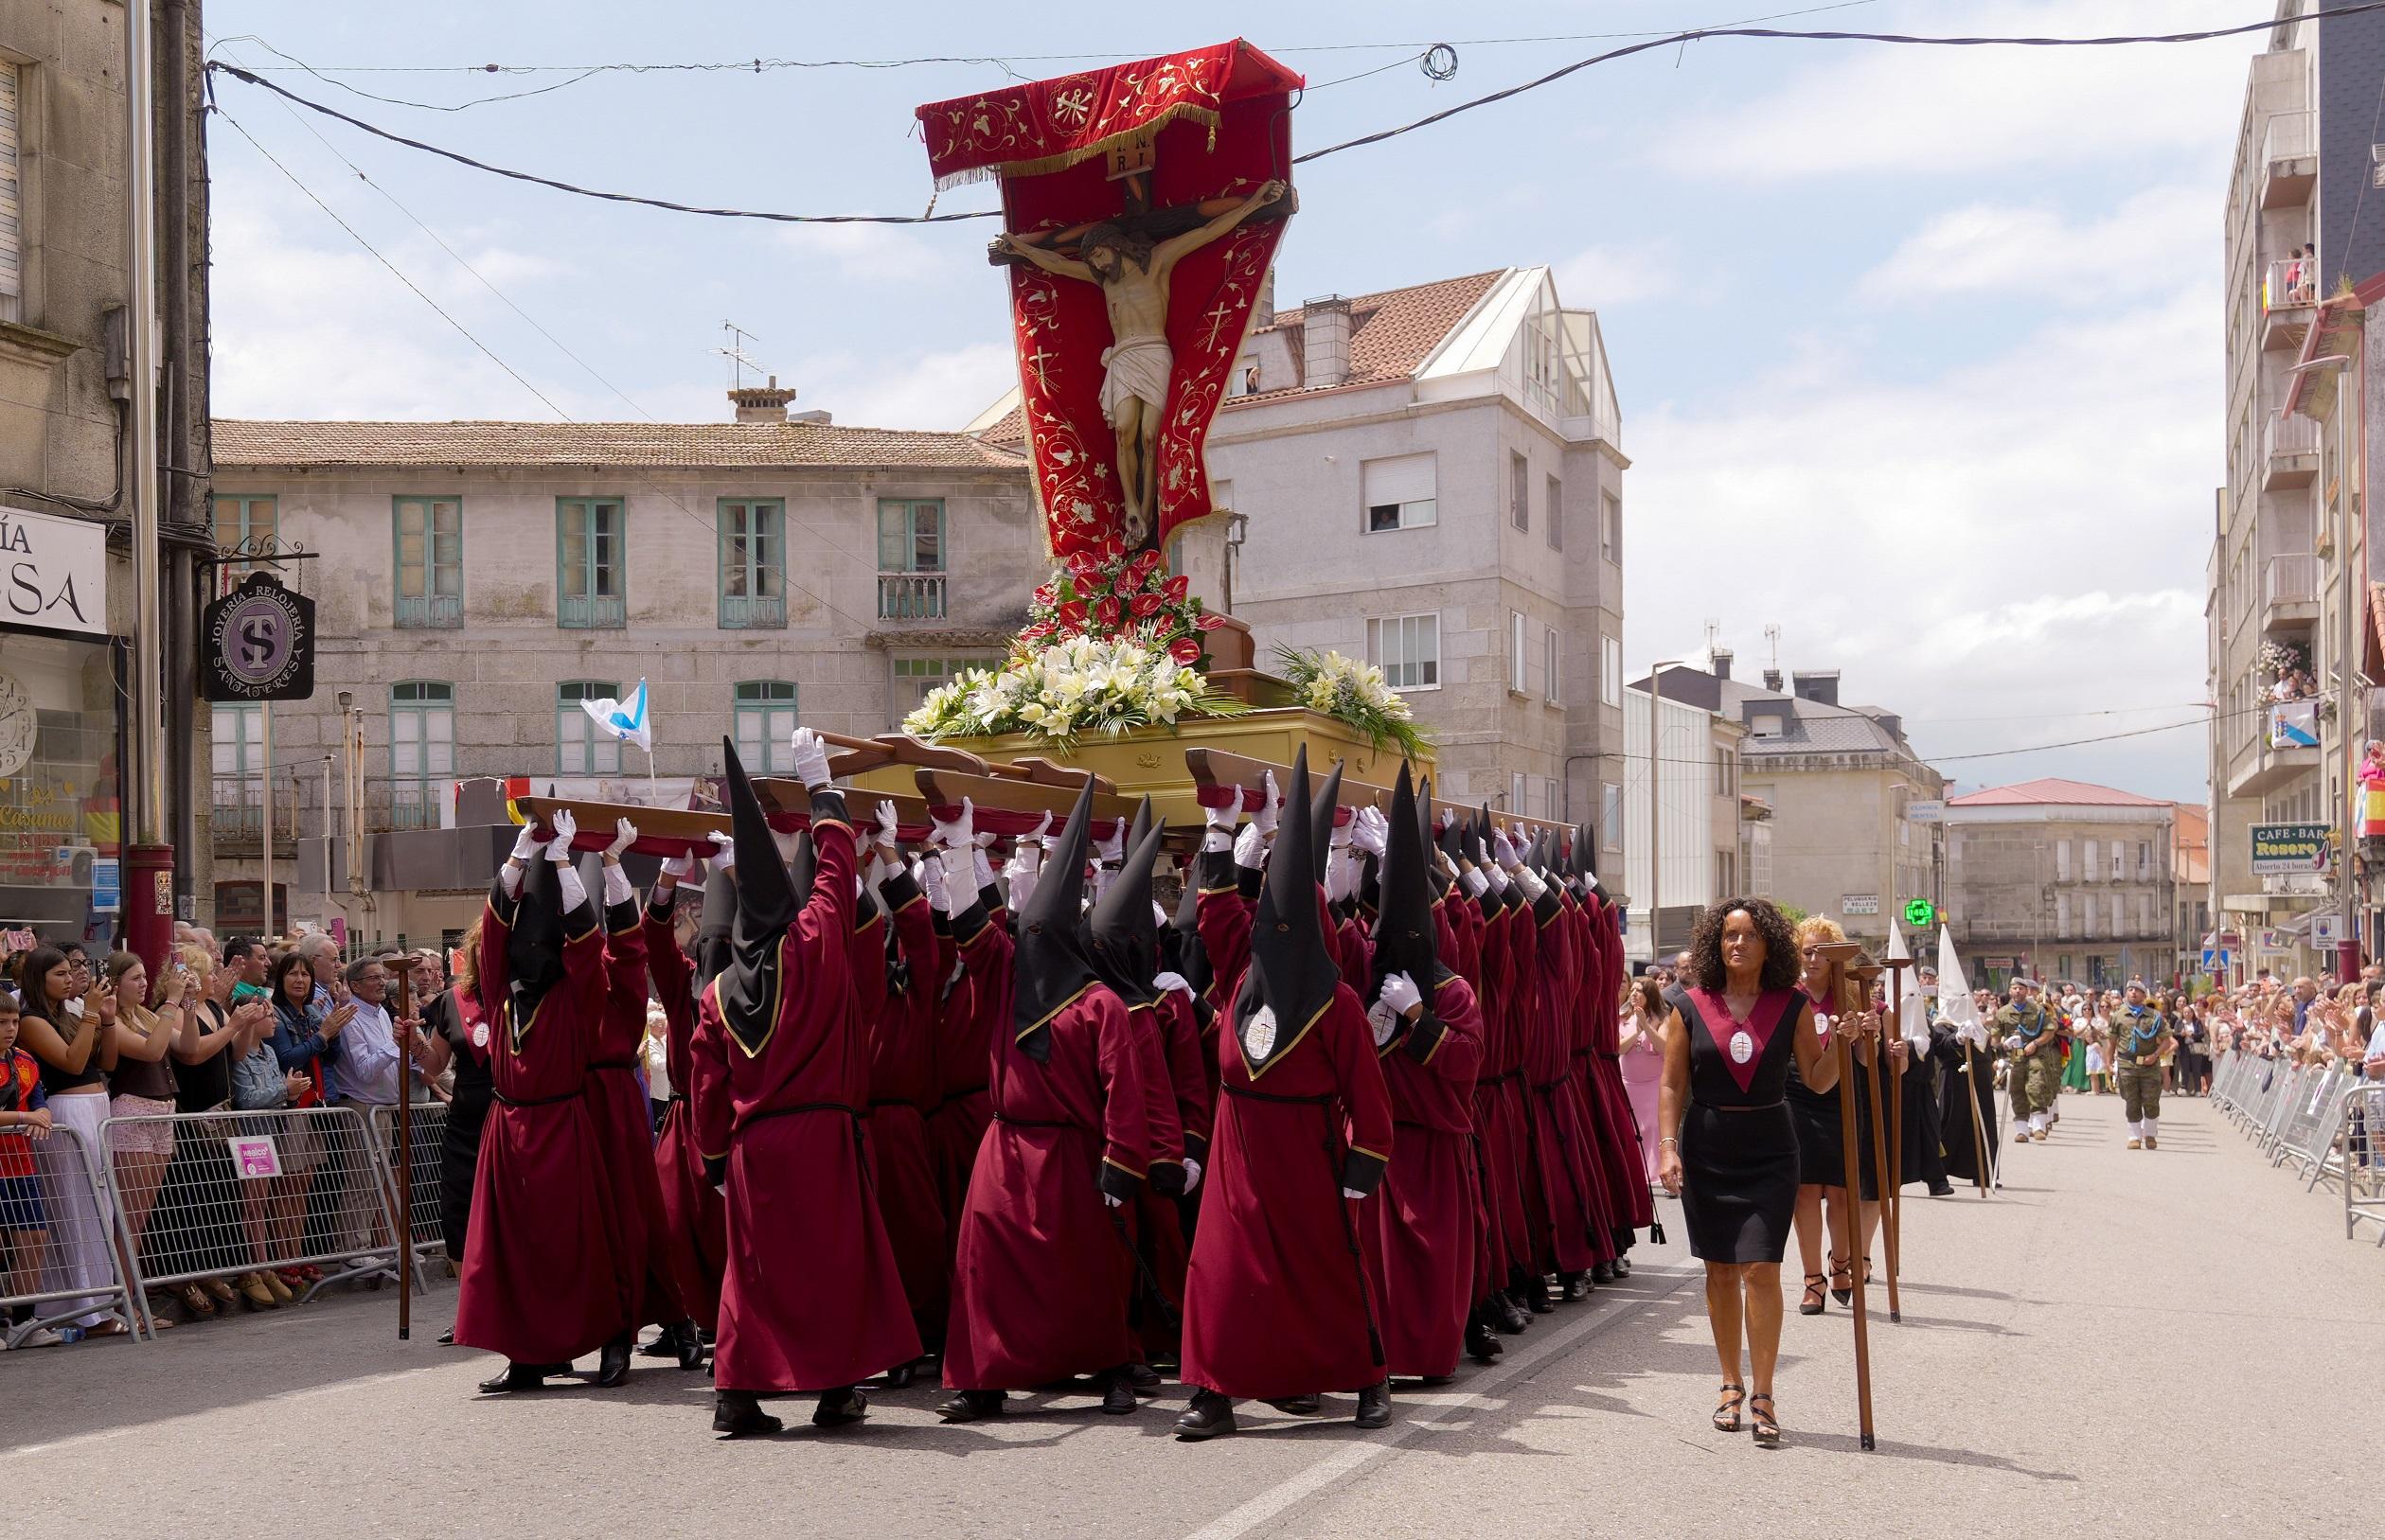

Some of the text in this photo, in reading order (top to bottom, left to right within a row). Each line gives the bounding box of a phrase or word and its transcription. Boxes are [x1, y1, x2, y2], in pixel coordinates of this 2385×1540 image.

[0, 514, 32, 554] ÍA
[0, 562, 88, 624] SA
[212, 592, 246, 646] JOYERÍA
[256, 586, 305, 641] RELOJERÍA
[2257, 828, 2289, 841] CAFE
[2298, 827, 2326, 840] BAR
